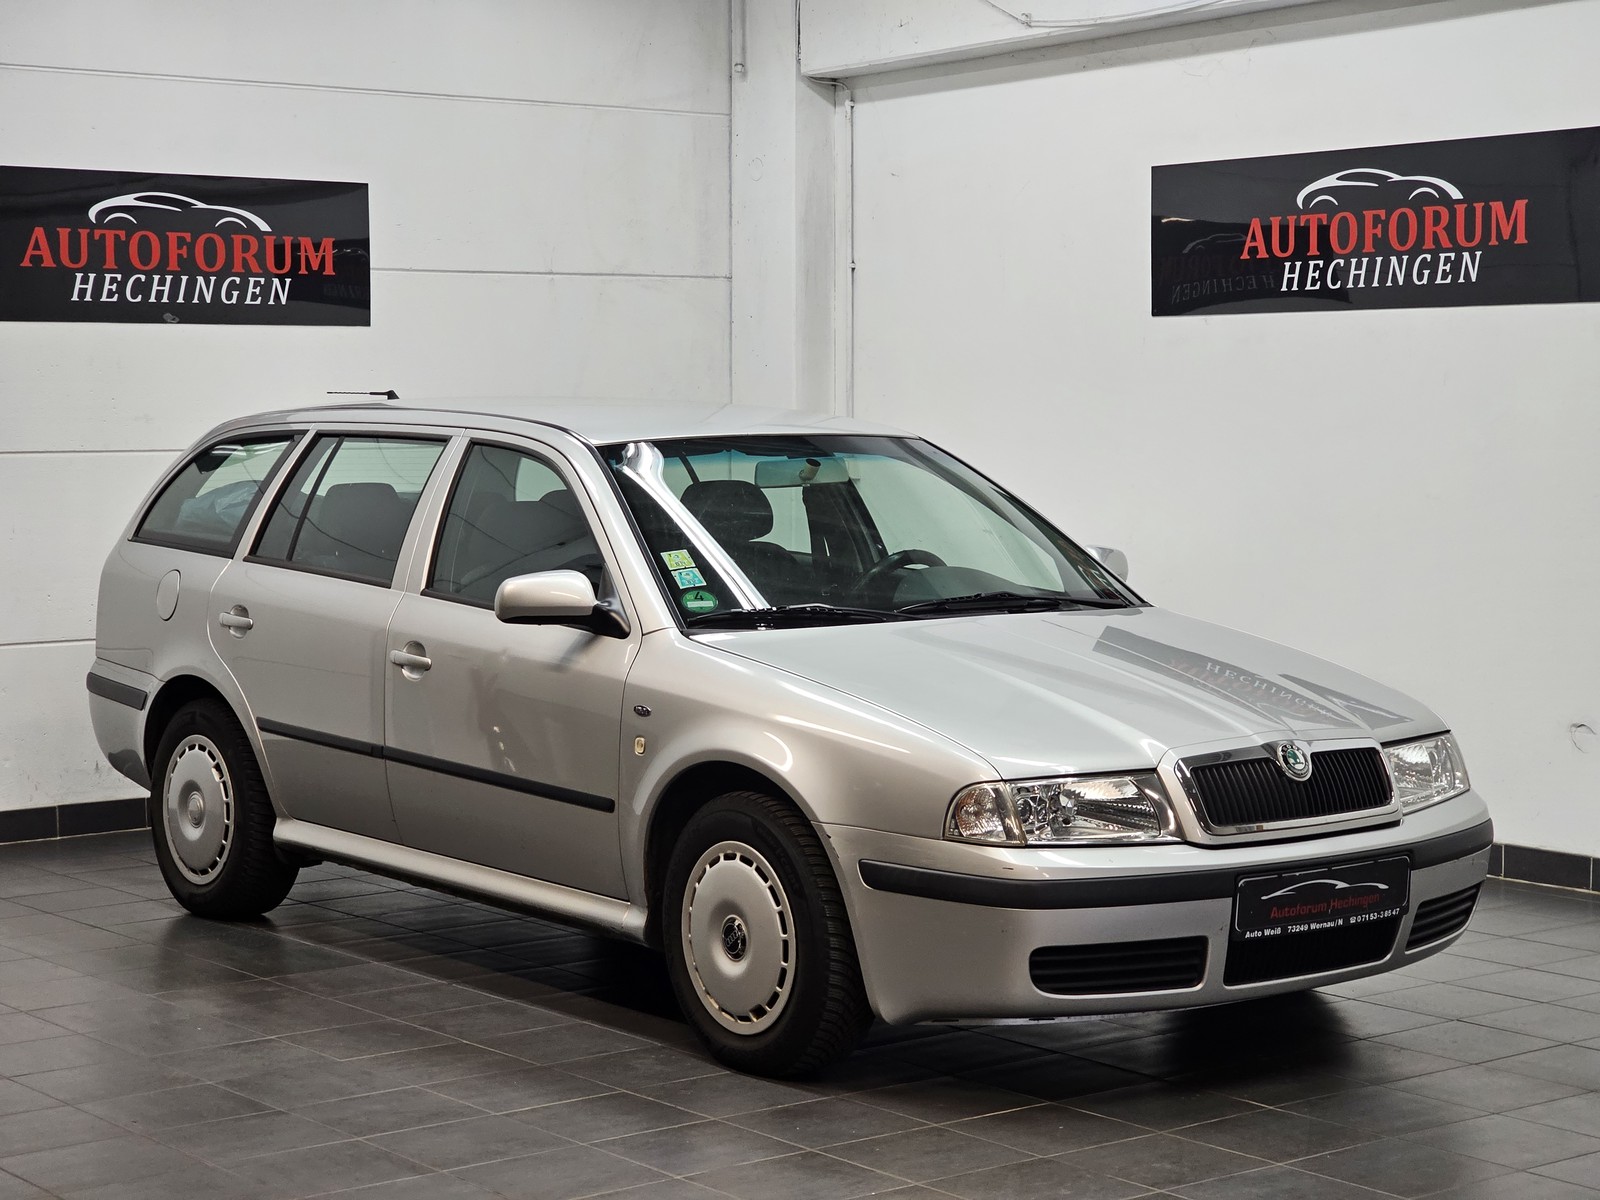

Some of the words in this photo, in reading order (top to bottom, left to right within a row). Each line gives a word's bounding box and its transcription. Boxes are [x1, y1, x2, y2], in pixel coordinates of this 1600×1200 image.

[1239, 198, 1528, 260] AUTOFORUM
[20, 226, 336, 276] AUTOFORUM
[1280, 251, 1482, 291] HECHINGEN
[71, 272, 292, 305] HECHINGEN
[695, 591, 704, 601] 4
[1270, 902, 1328, 919] Autoforum
[1330, 893, 1380, 909] Hechingen
[1245, 930, 1262, 939] Auto
[1264, 926, 1282, 937] Weiß
[1287, 923, 1309, 934] 73249
[1310, 918, 1344, 930] Wernau/N
